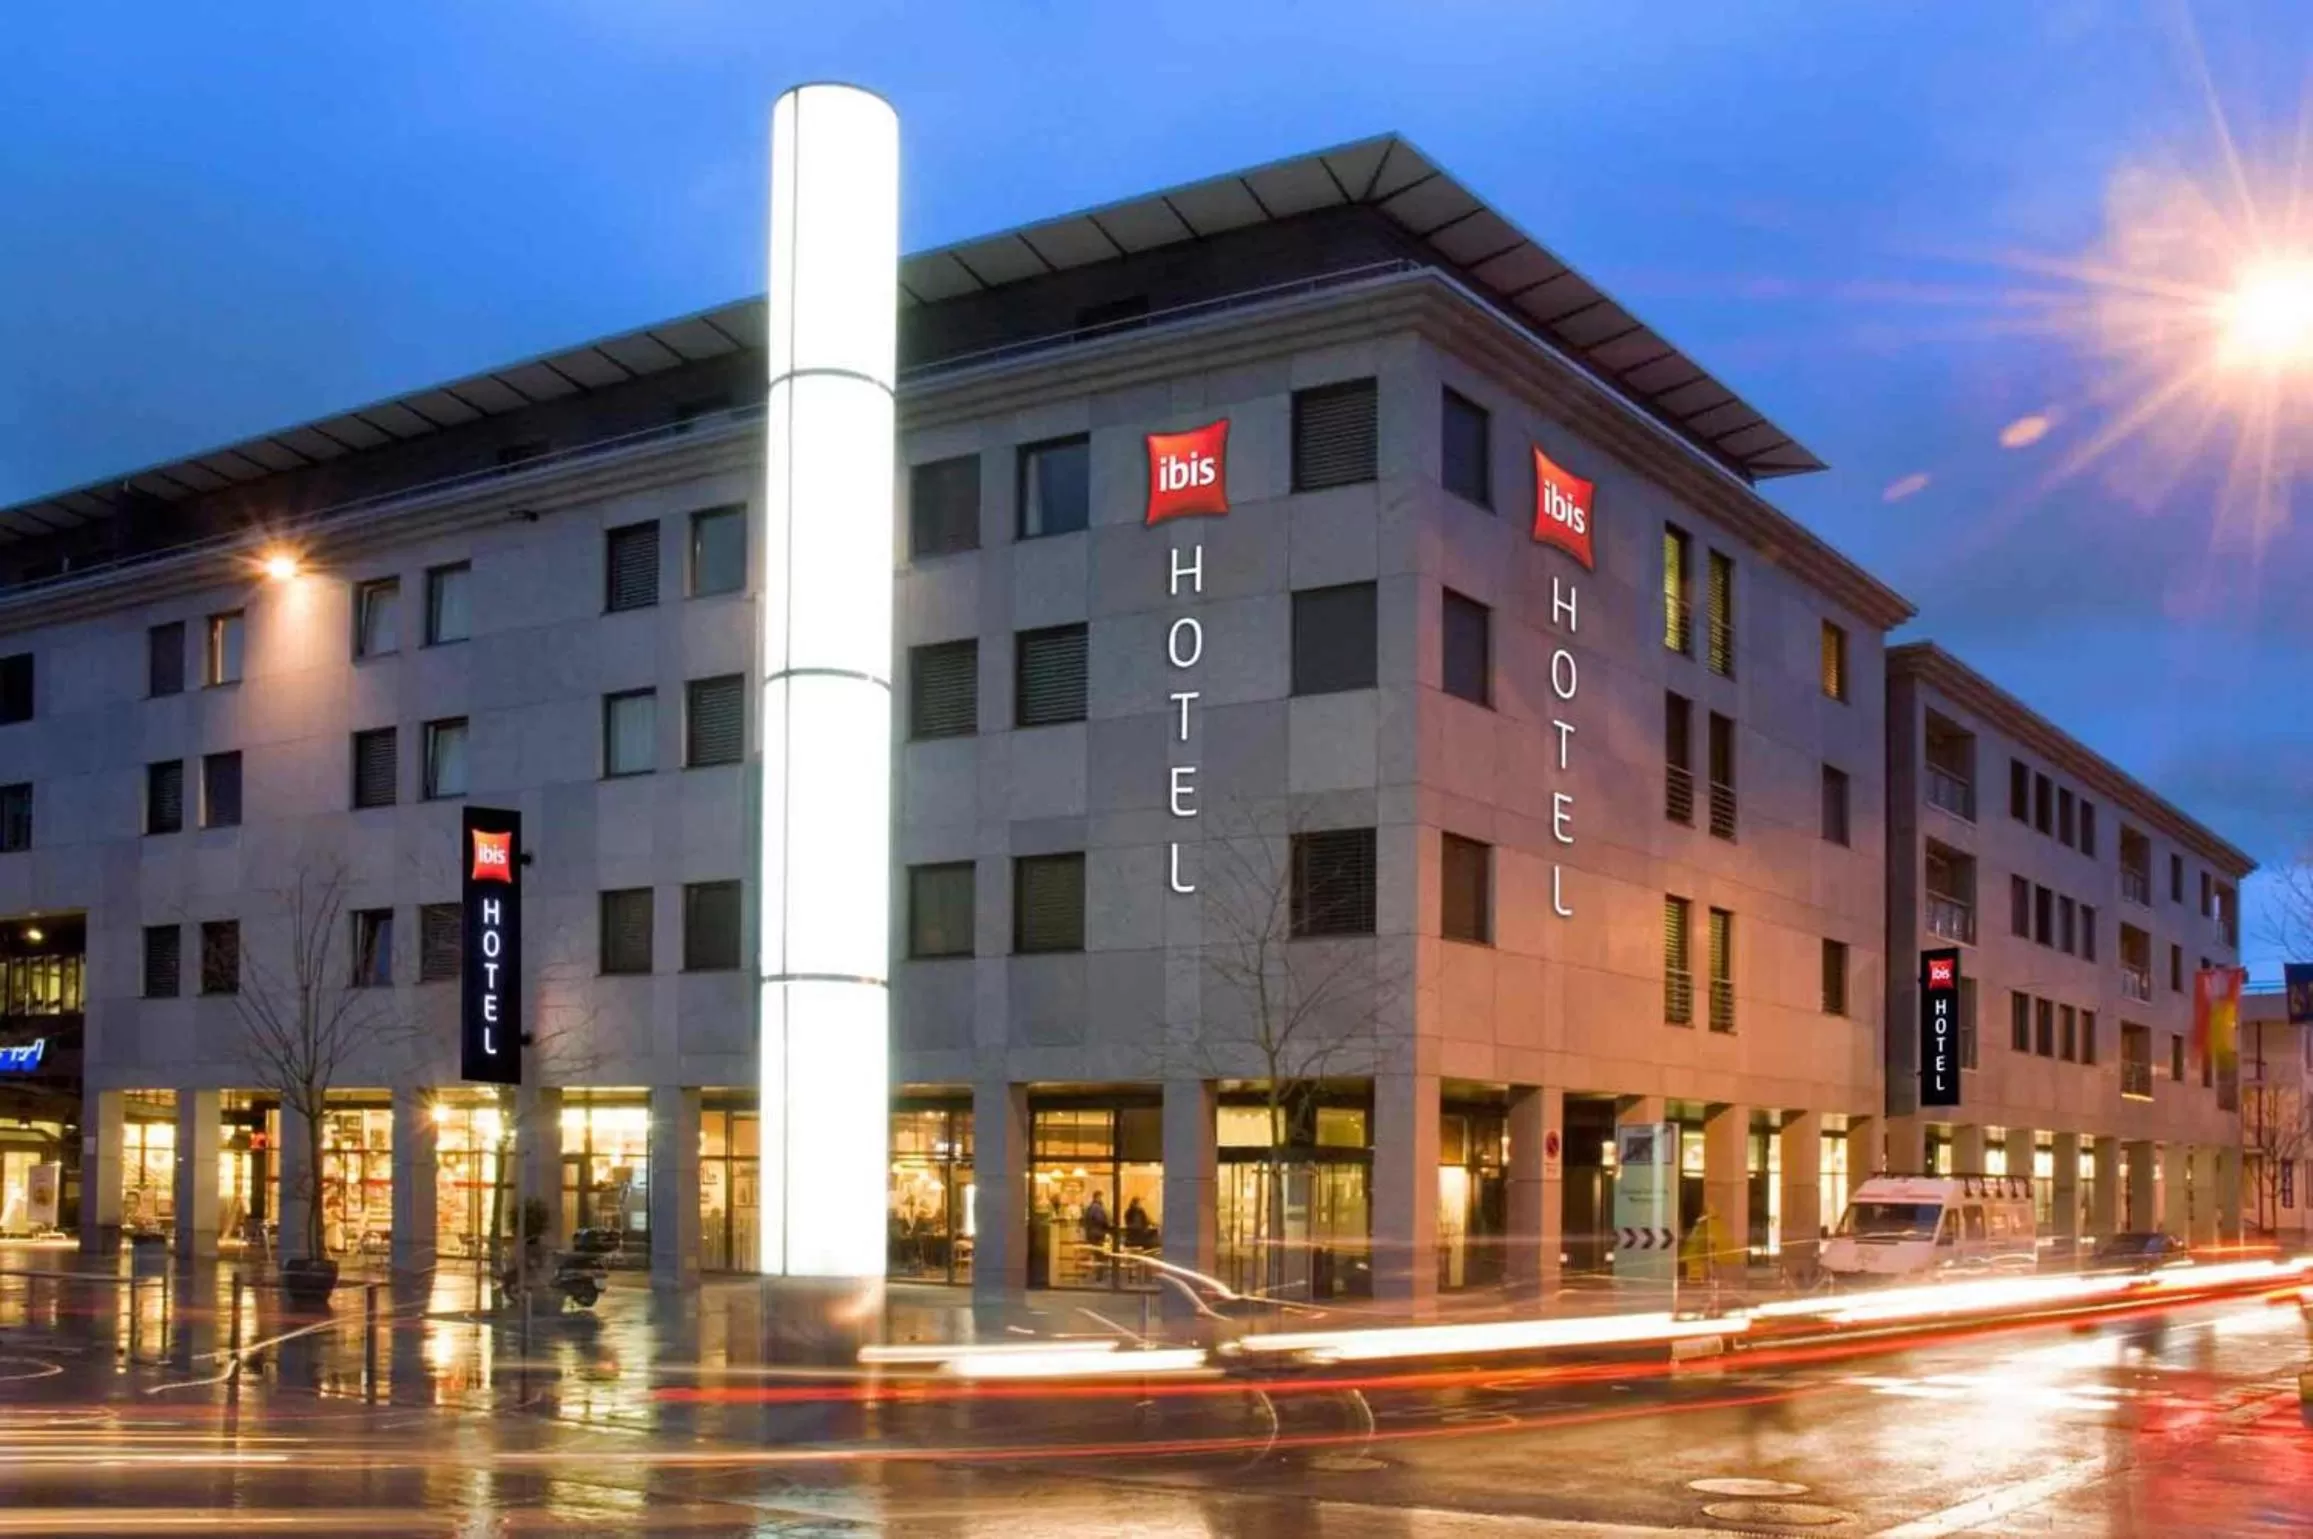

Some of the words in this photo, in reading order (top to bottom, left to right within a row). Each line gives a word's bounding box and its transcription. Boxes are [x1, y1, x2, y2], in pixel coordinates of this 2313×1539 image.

[1159, 451, 1215, 492] ibis
[1543, 480, 1585, 534] ibis
[1168, 545, 1203, 894] HOTEL
[1551, 577, 1578, 917] HOTEL
[478, 843, 505, 865] ibis
[483, 898, 499, 1055] HOTEL
[1931, 967, 1950, 980] ibis
[1935, 999, 1947, 1091] HOTEL
